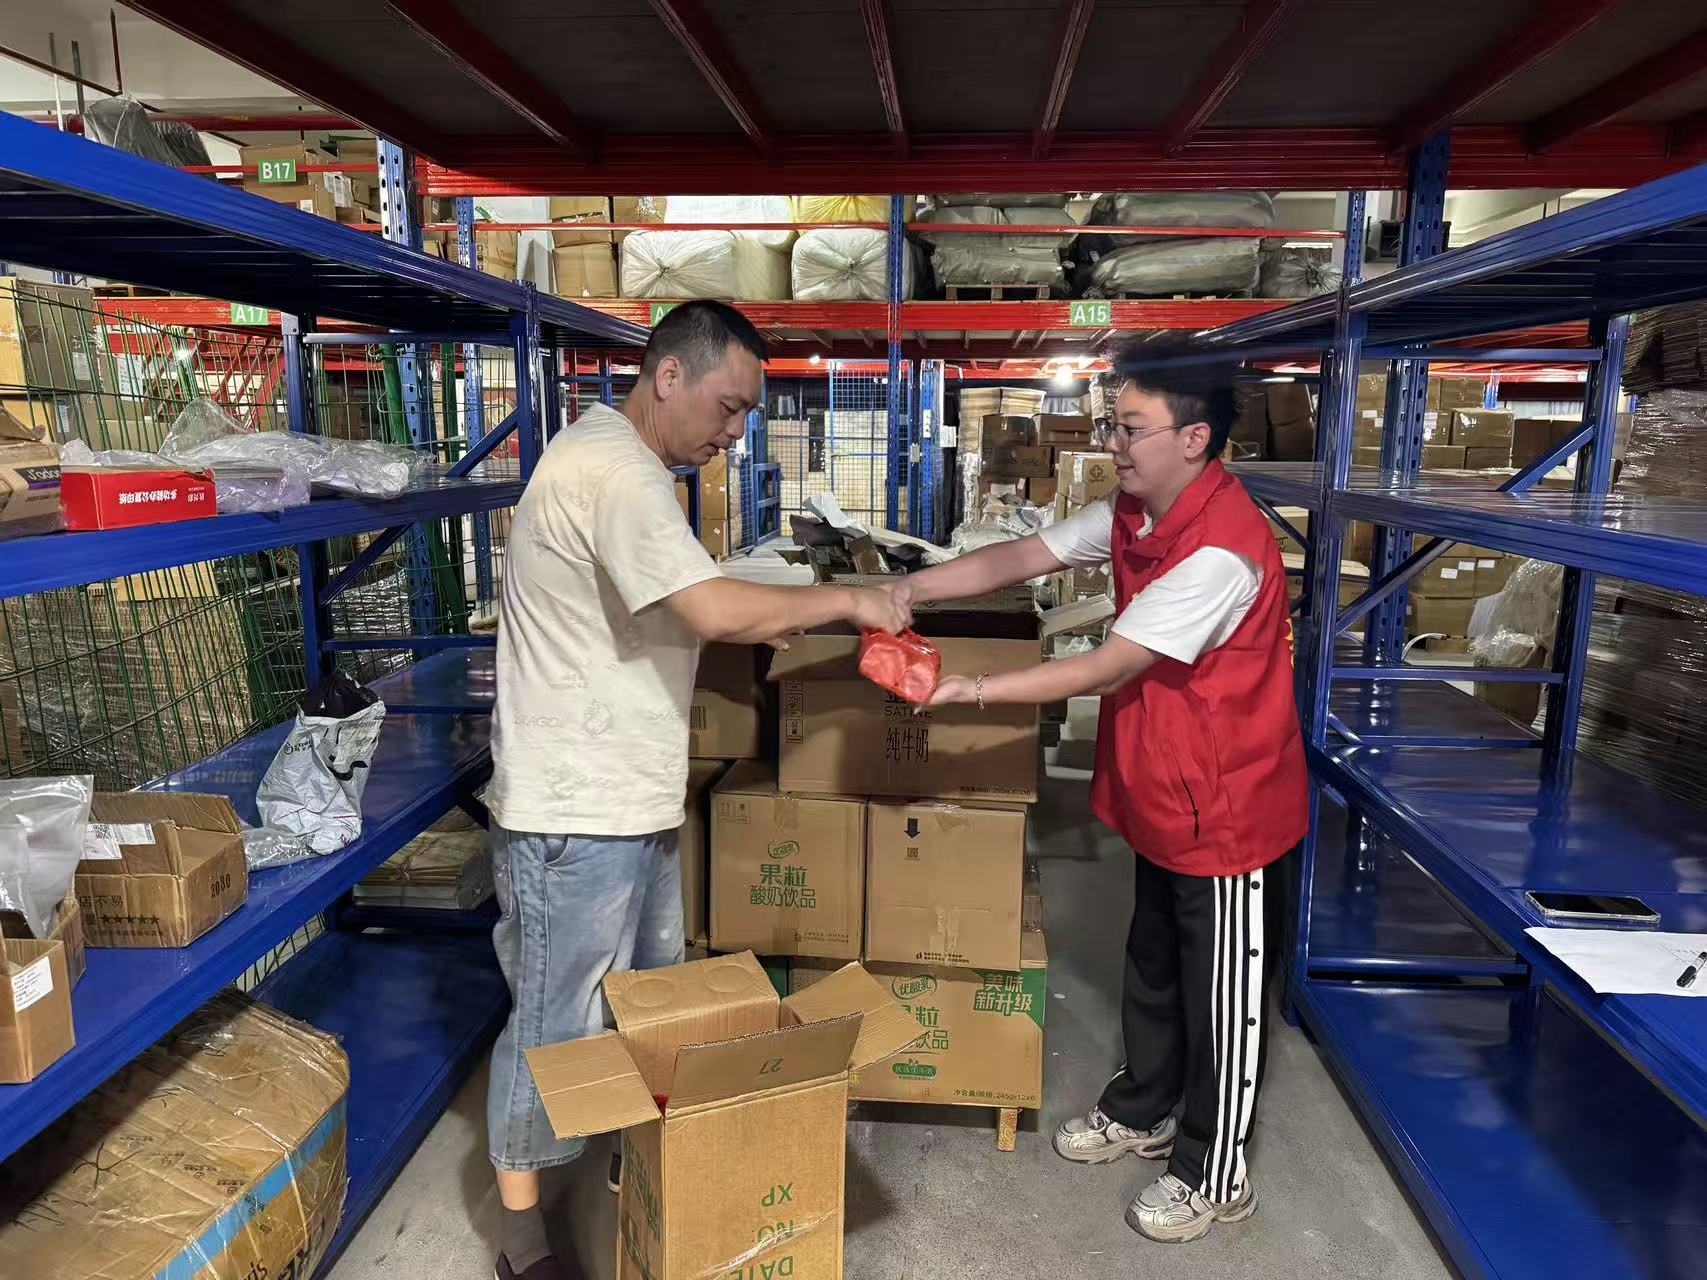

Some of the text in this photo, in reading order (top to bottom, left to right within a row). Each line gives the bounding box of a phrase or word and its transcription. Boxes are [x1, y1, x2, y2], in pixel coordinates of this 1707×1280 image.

[262, 162, 291, 179] B17
[235, 305, 264, 322] A17
[654, 305, 673, 325] A
[1073, 304, 1107, 323] A15
[886, 727, 929, 763] 纯牛奶
[760, 864, 807, 886] 果粒
[210, 873, 231, 899] 2080
[750, 885, 816, 908] 酸奶饮品
[984, 974, 1024, 993] 美味
[975, 991, 1033, 1015] 新升级
[760, 1058, 783, 1074] 27
[761, 1183, 793, 1207] XP
